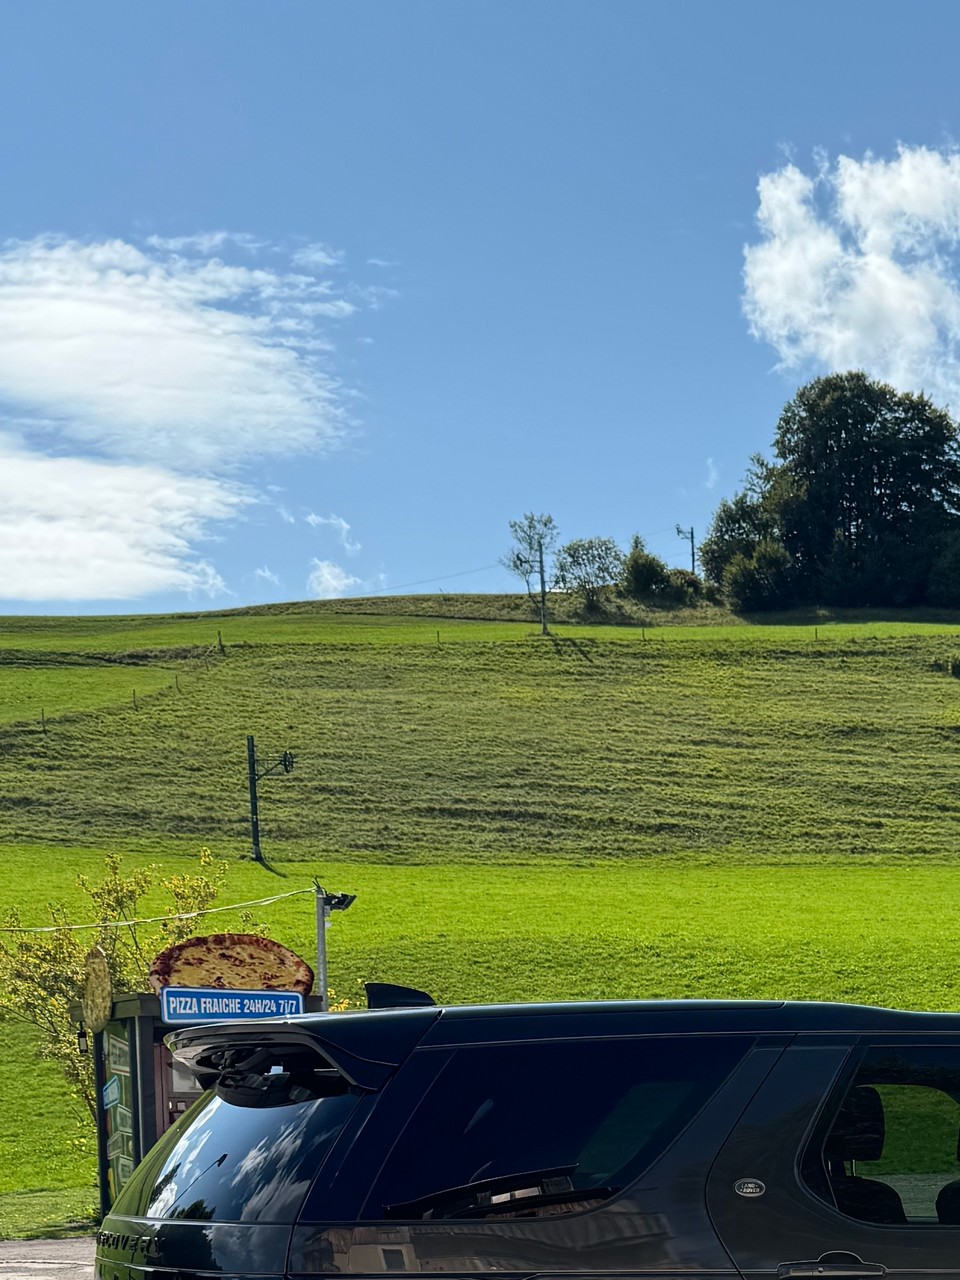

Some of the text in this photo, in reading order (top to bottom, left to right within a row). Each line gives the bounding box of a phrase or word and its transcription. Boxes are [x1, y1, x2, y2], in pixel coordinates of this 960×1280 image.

[169, 997, 297, 1015] PIZZA FRAICHE 24H/24 7j/7
